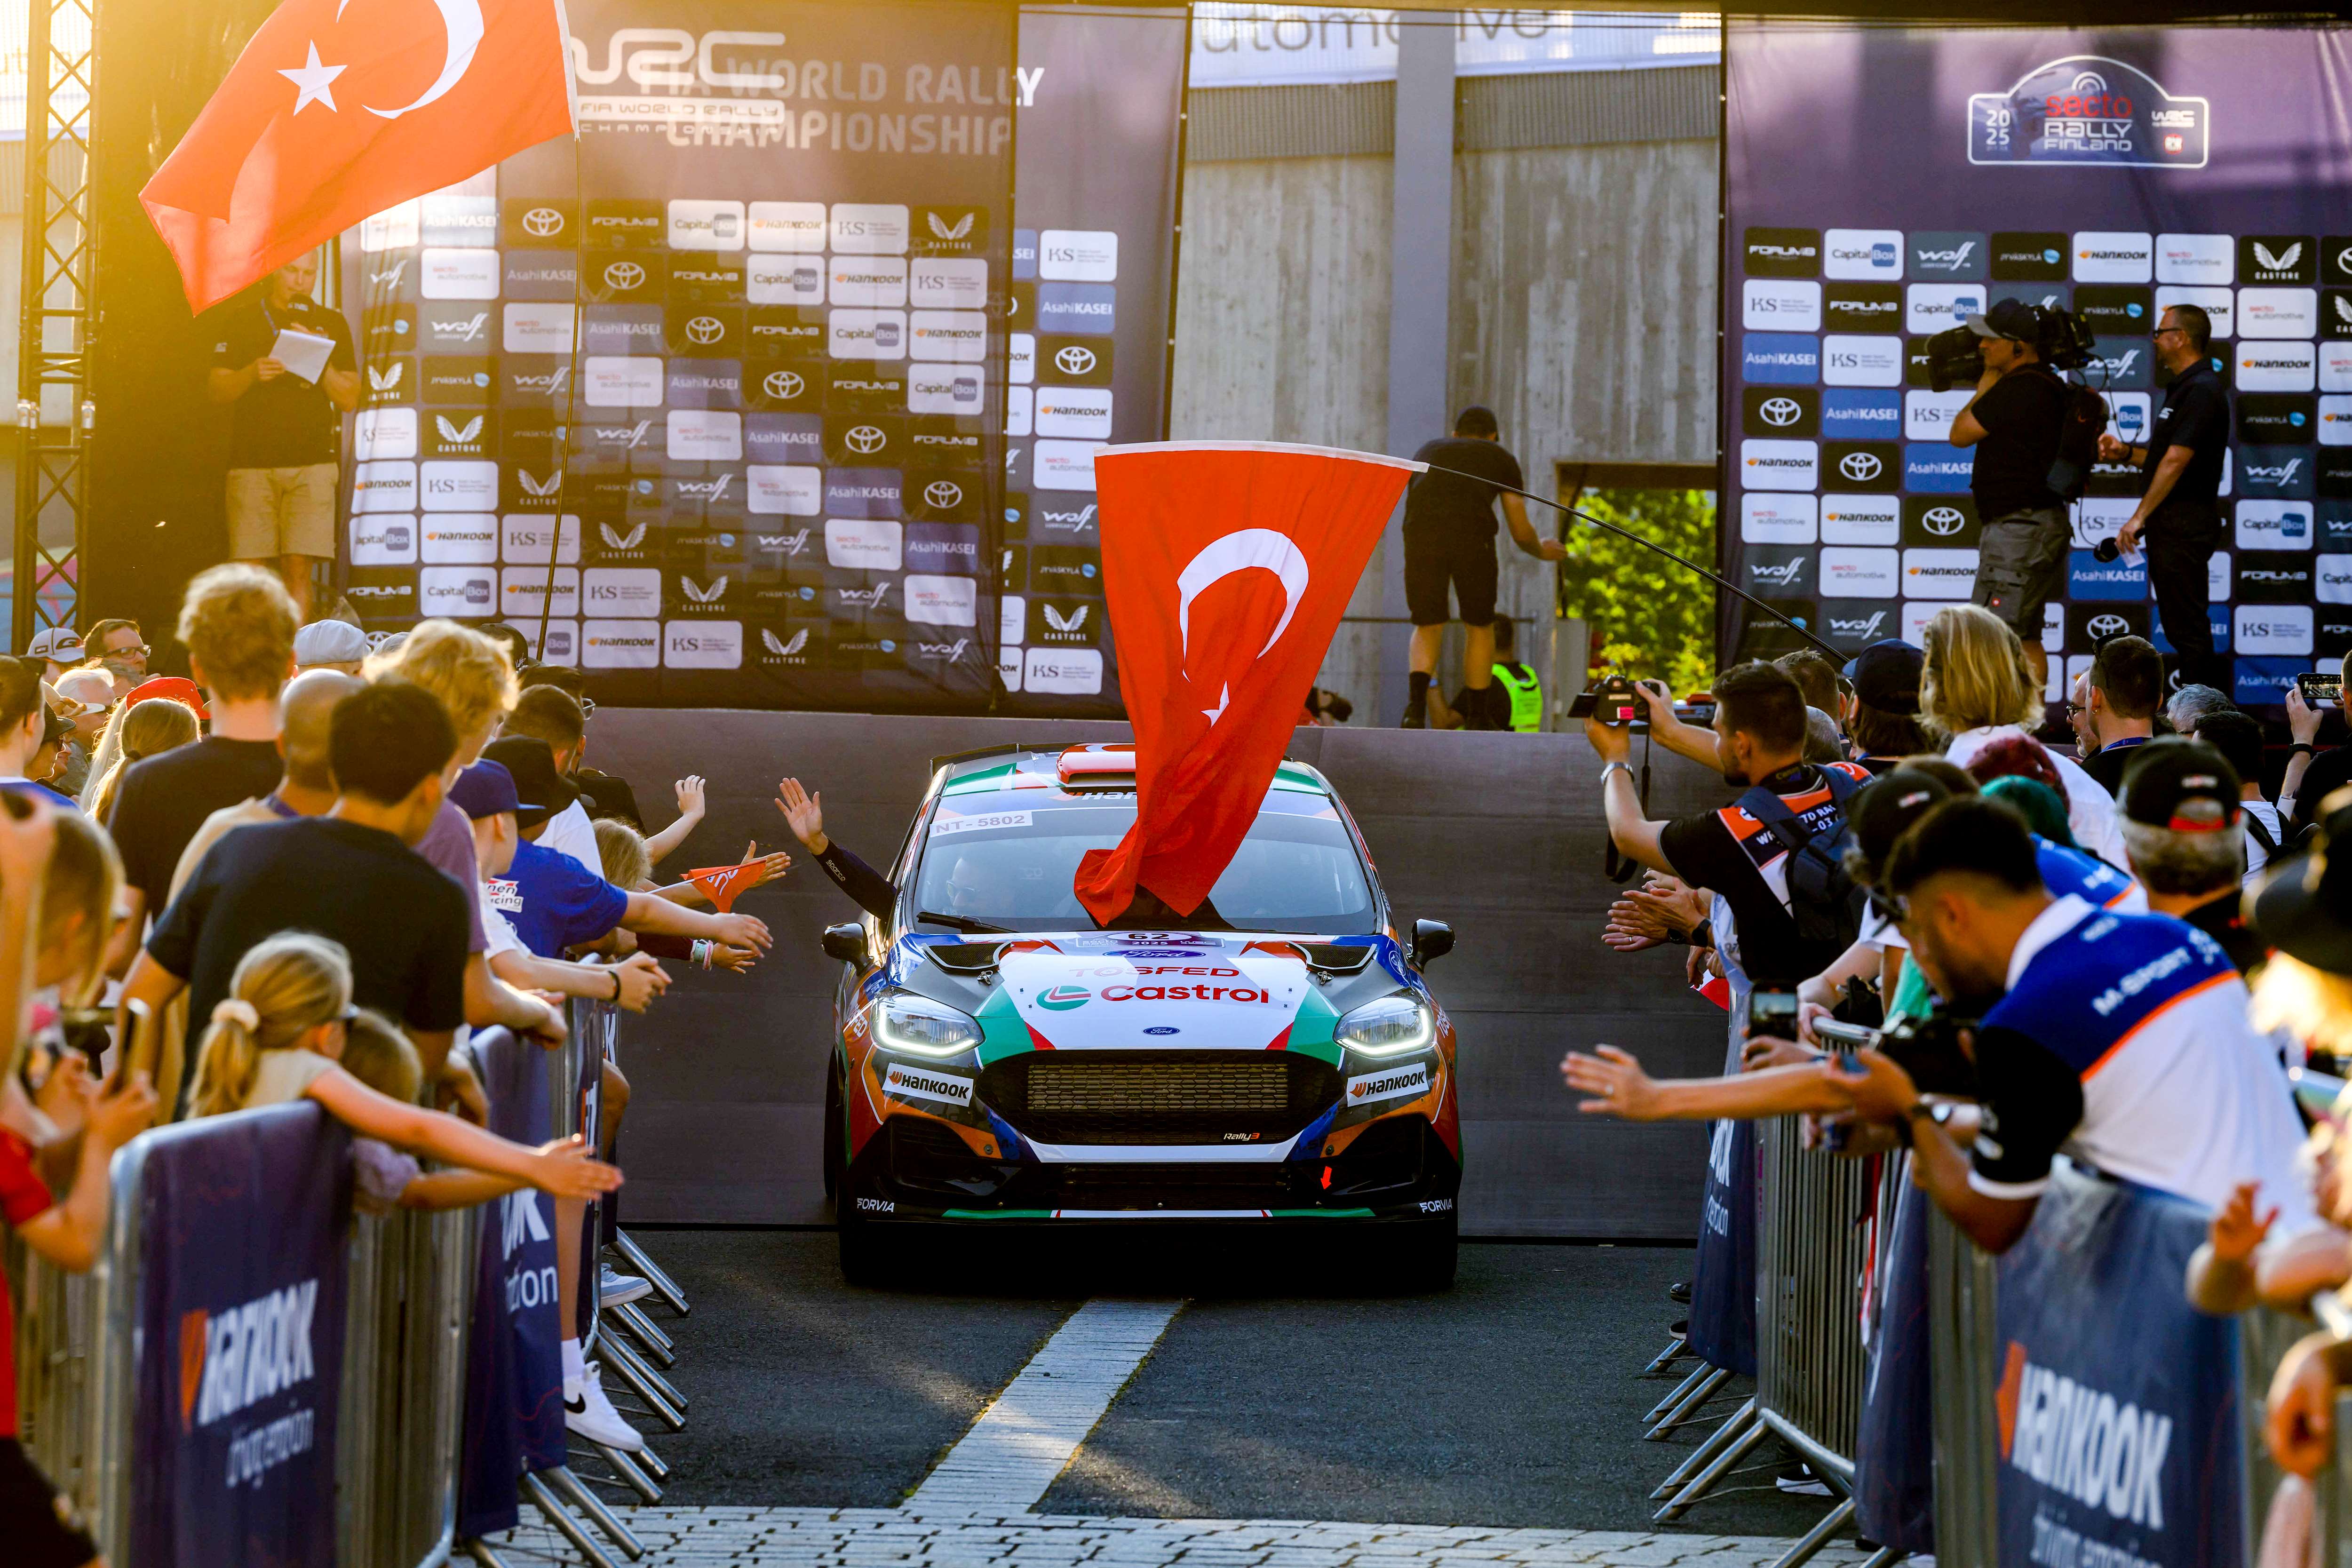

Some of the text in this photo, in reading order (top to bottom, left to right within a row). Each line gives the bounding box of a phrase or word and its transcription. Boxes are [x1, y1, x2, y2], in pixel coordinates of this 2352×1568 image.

[580, 103, 612, 113] FIA
[619, 103, 696, 114] WORLD
[2046, 93, 2133, 118] secto
[1986, 110, 2010, 126] 20
[1986, 128, 2010, 145] 25
[2044, 121, 2132, 138] RALLY
[2044, 139, 2132, 151] FINLAND
[839, 222, 865, 236] KS
[1048, 248, 1074, 262] KS
[918, 276, 944, 289] KS
[2255, 271, 2299, 280] CASTORE
[1751, 298, 1777, 312] KS
[1831, 353, 1858, 368] KS
[1913, 408, 1940, 422] KS
[438, 444, 481, 453] CASTORE
[429, 479, 454, 493] KS
[510, 532, 536, 546] KS
[591, 585, 617, 599] KS
[2242, 623, 2269, 638] KS
[672, 637, 699, 651] KS
[1033, 665, 1058, 678] KS
[826, 860, 845, 882] sparco
[1069, 967, 1239, 977] TOSFED
[1100, 985, 1269, 1003] Castrol
[902, 1074, 970, 1099] HANKOOK
[1366, 1071, 1425, 1096] HANKOOK
[1223, 1132, 1260, 1141] Rally3
[857, 1198, 895, 1213] FORVIA
[1419, 1198, 1453, 1213] FORVIA
